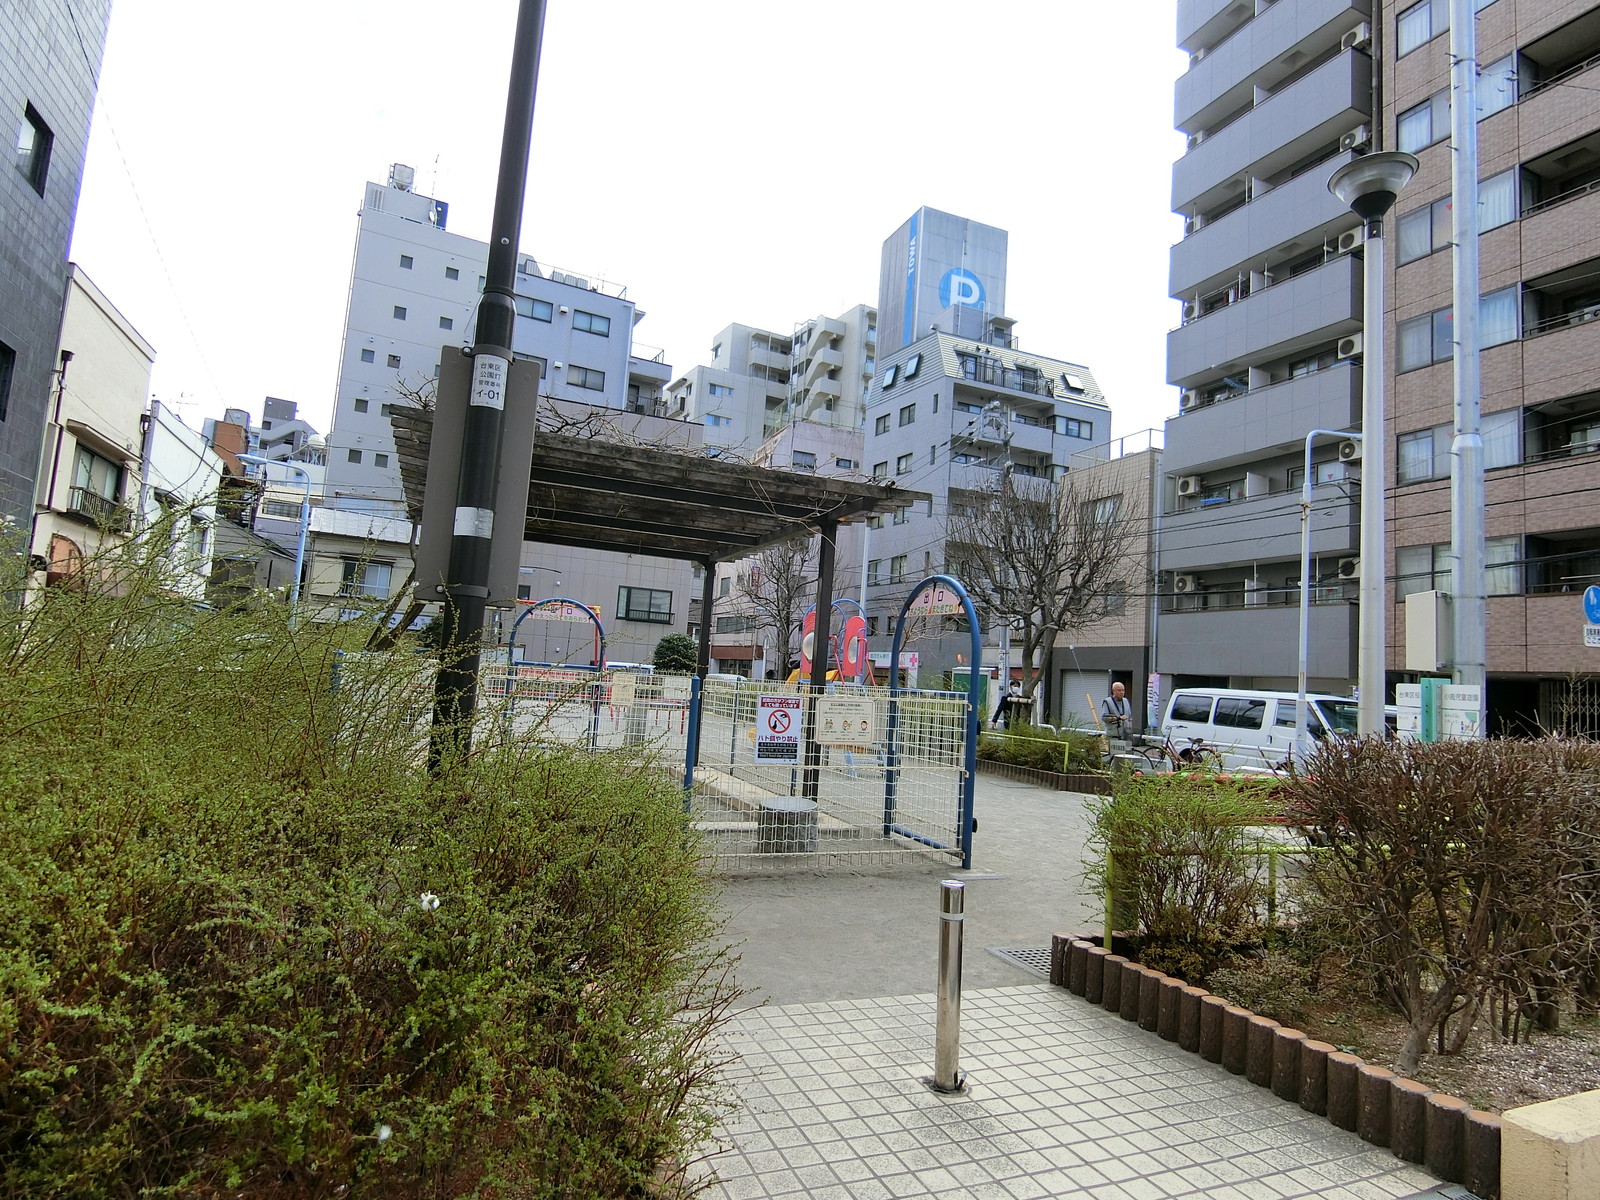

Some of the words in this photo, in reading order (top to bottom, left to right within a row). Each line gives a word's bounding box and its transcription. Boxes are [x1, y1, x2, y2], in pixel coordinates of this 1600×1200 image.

[950, 274, 980, 307] P
[481, 362, 501, 372] 台東区
[480, 371, 501, 380] 公園灯
